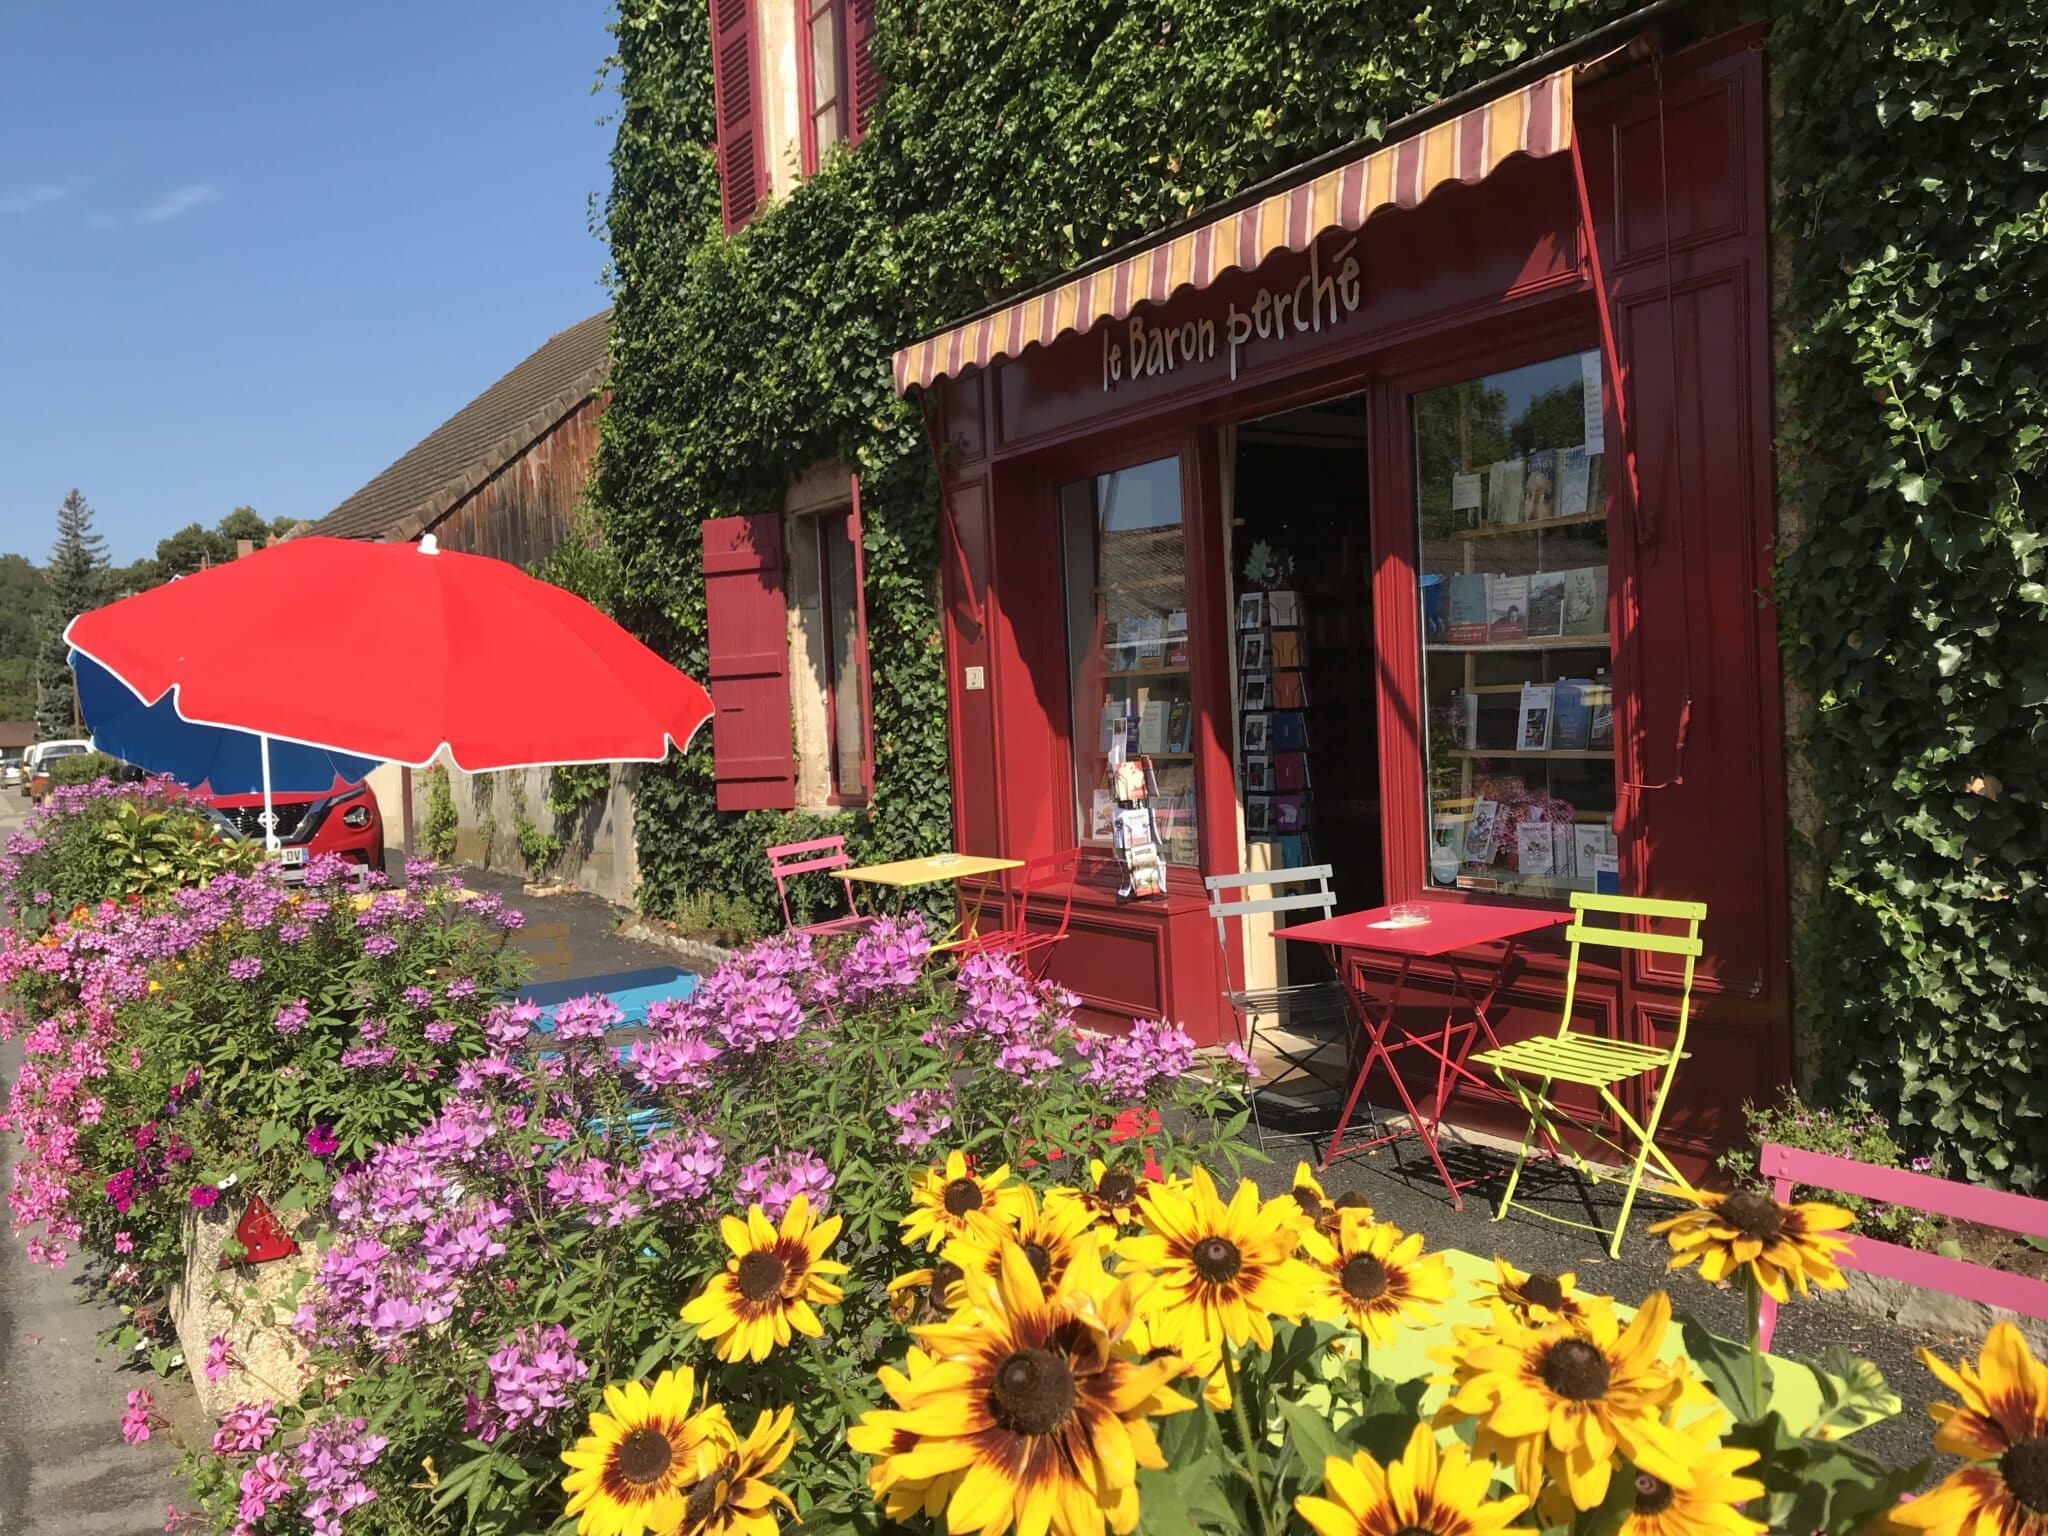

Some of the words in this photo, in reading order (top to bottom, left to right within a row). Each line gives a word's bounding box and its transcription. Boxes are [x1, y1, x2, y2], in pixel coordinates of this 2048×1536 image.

[1103, 329, 1121, 392] le
[1130, 317, 1214, 381] Baron
[1227, 237, 1360, 381] perché
